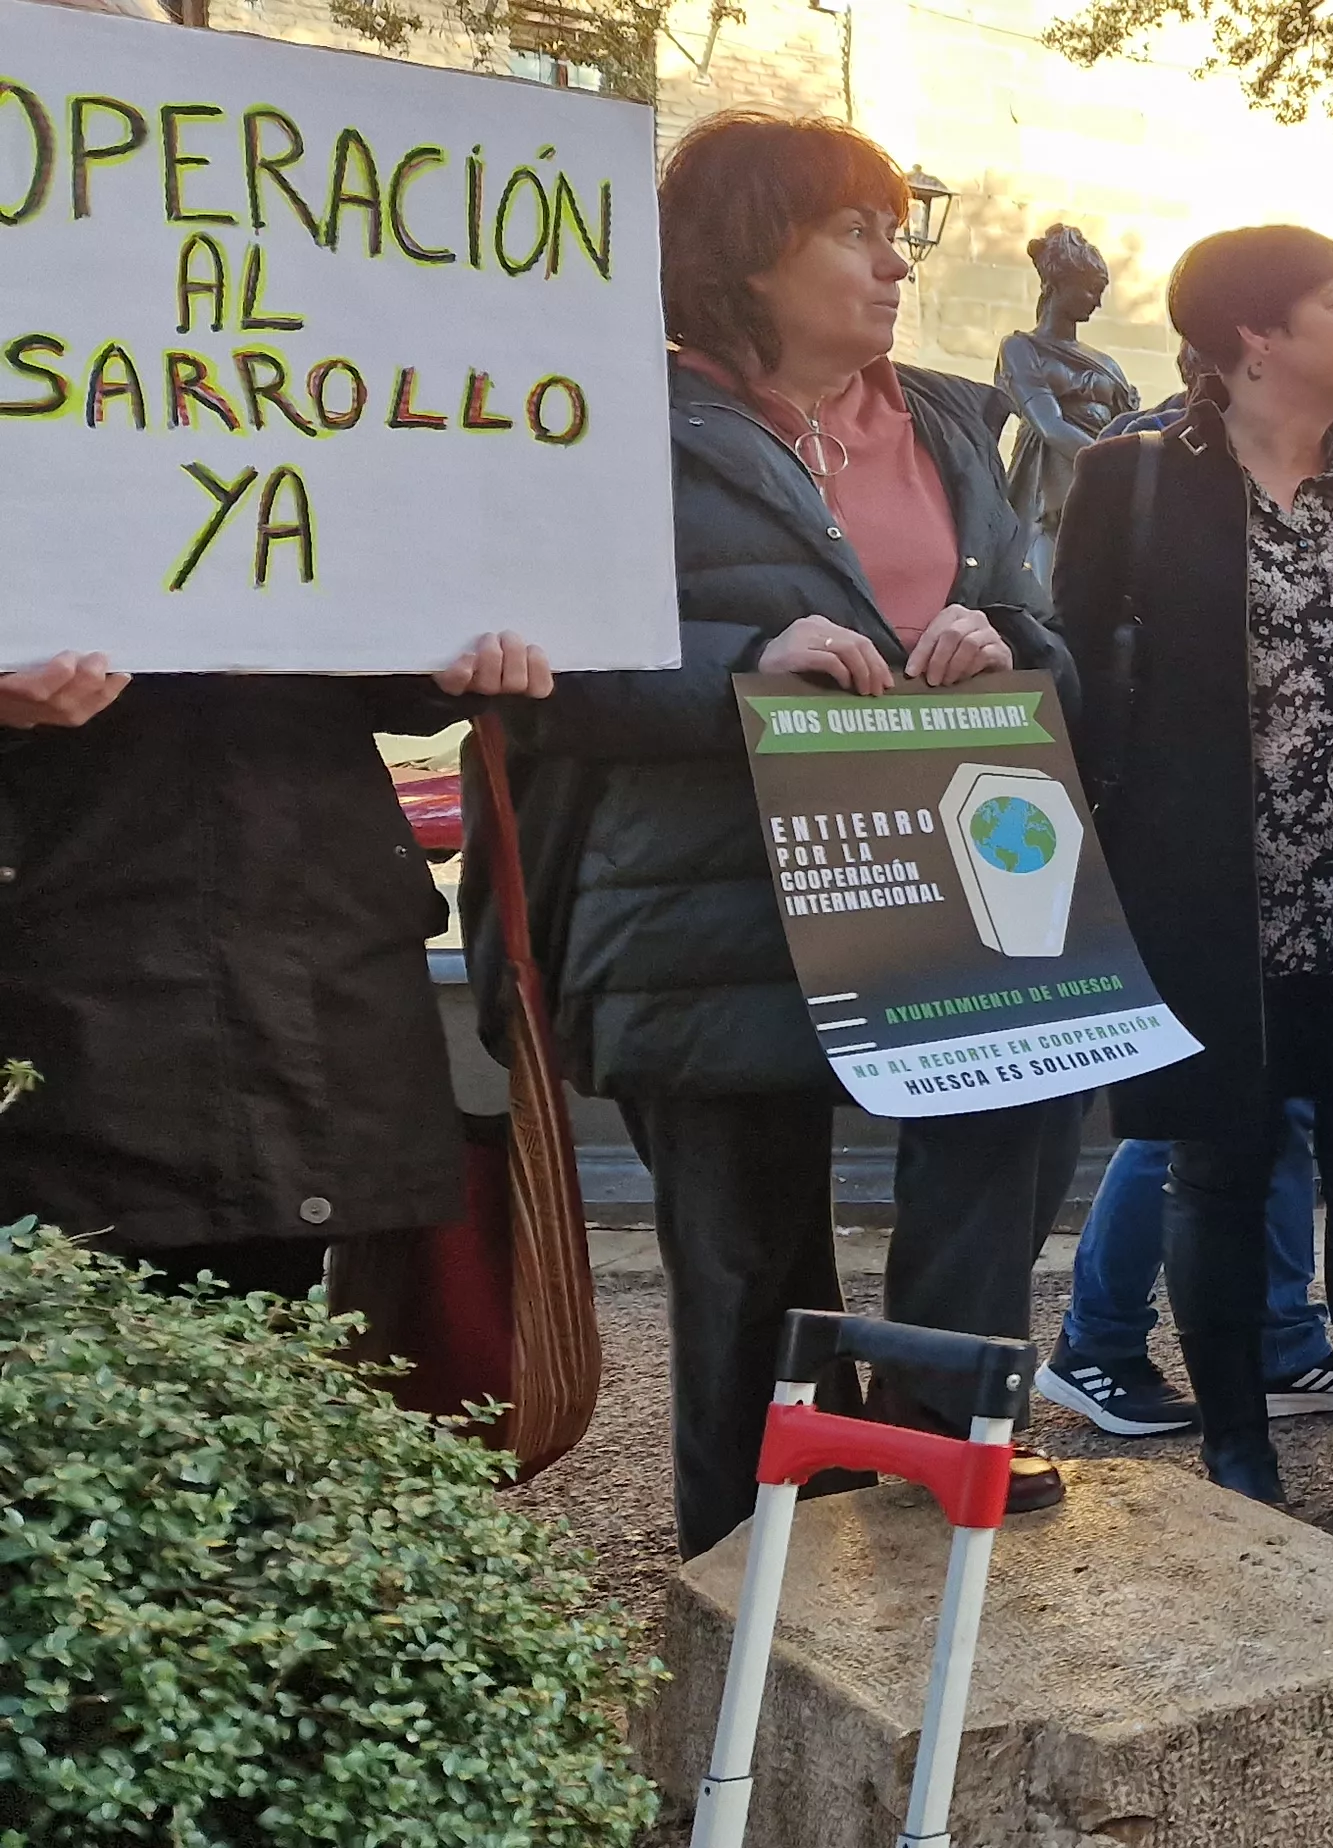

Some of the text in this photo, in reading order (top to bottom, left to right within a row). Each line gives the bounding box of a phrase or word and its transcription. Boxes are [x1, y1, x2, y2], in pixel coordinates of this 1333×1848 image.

[176, 231, 304, 333] AL
[0, 334, 588, 445] SARROLLO
[168, 461, 314, 591] YA
[770, 705, 1029, 736] ¡NOS QUIEREN ENTERRAR!
[770, 808, 935, 843] ENTIERRO
[777, 842, 873, 868] POR LA
[780, 858, 920, 892] COOPERACIÓN
[785, 882, 946, 917] INTERNACIONAL
[884, 974, 1124, 1025] AYUNTAMIENTO DE HUESCA
[852, 1014, 1162, 1079] NO AL RECORTE EN COOPERACIÓN
[904, 1041, 1140, 1096] HUESCA ES SOLIDARIA
